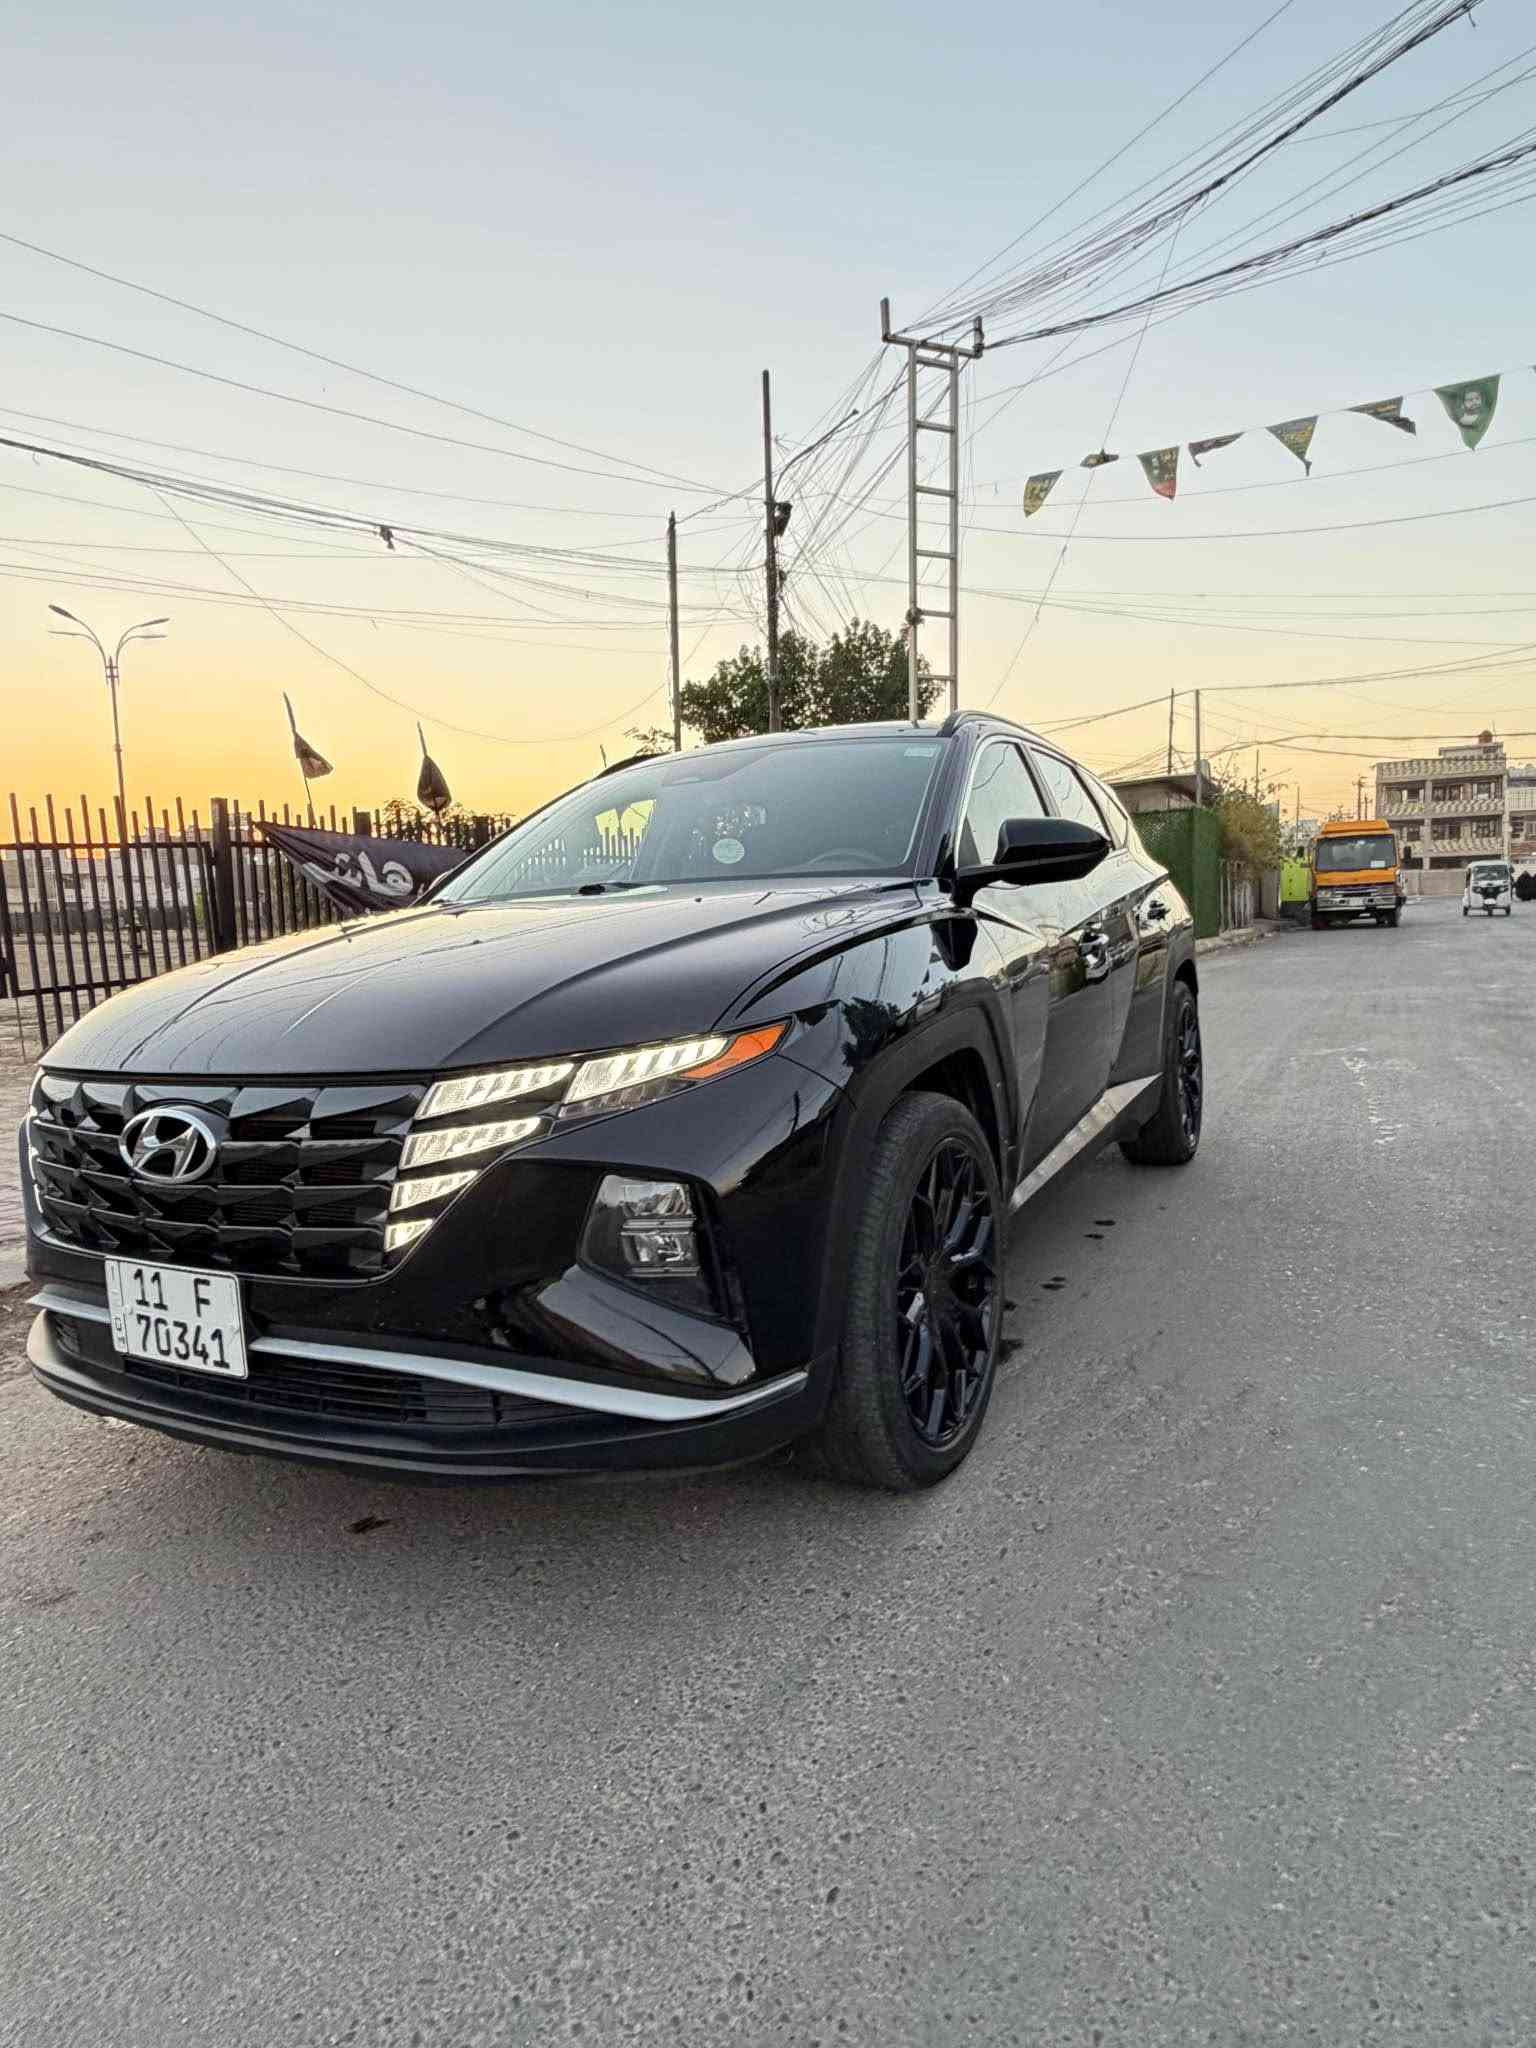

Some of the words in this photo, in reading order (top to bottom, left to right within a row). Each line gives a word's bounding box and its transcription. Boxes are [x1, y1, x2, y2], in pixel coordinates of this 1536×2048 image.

[133, 1268, 168, 1311] 11
[193, 1278, 211, 1318] F
[136, 1313, 230, 1369] 70341
